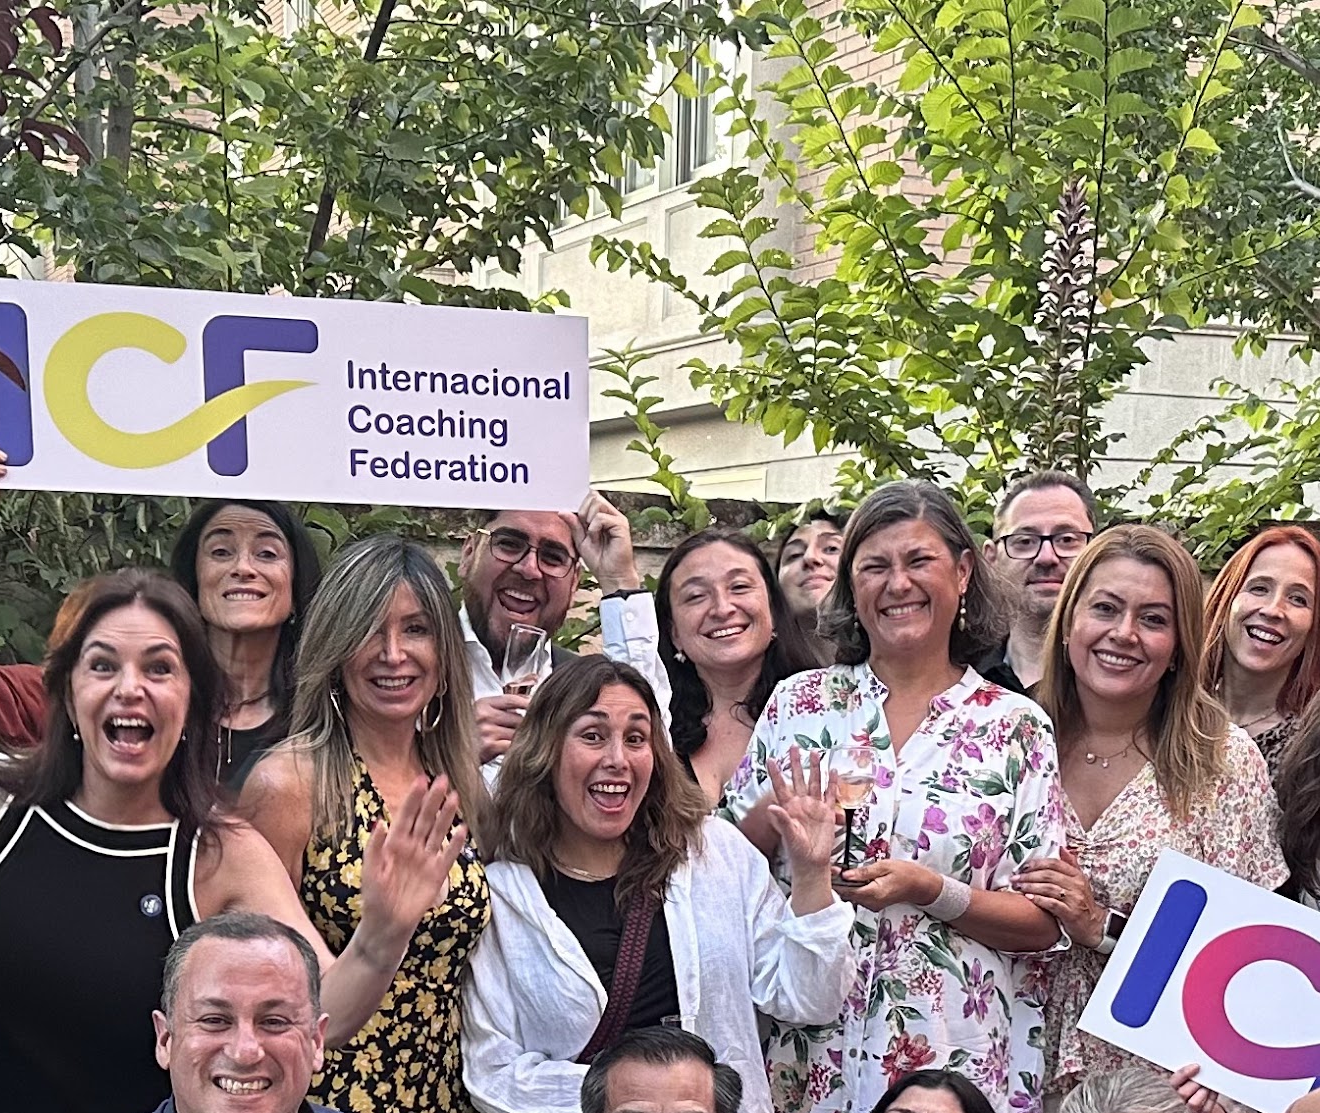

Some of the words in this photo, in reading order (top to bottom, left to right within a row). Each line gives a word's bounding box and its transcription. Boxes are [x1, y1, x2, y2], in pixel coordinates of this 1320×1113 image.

[347, 360, 571, 400] Internacional
[347, 405, 509, 447] Coaching
[349, 448, 530, 485] Federation
